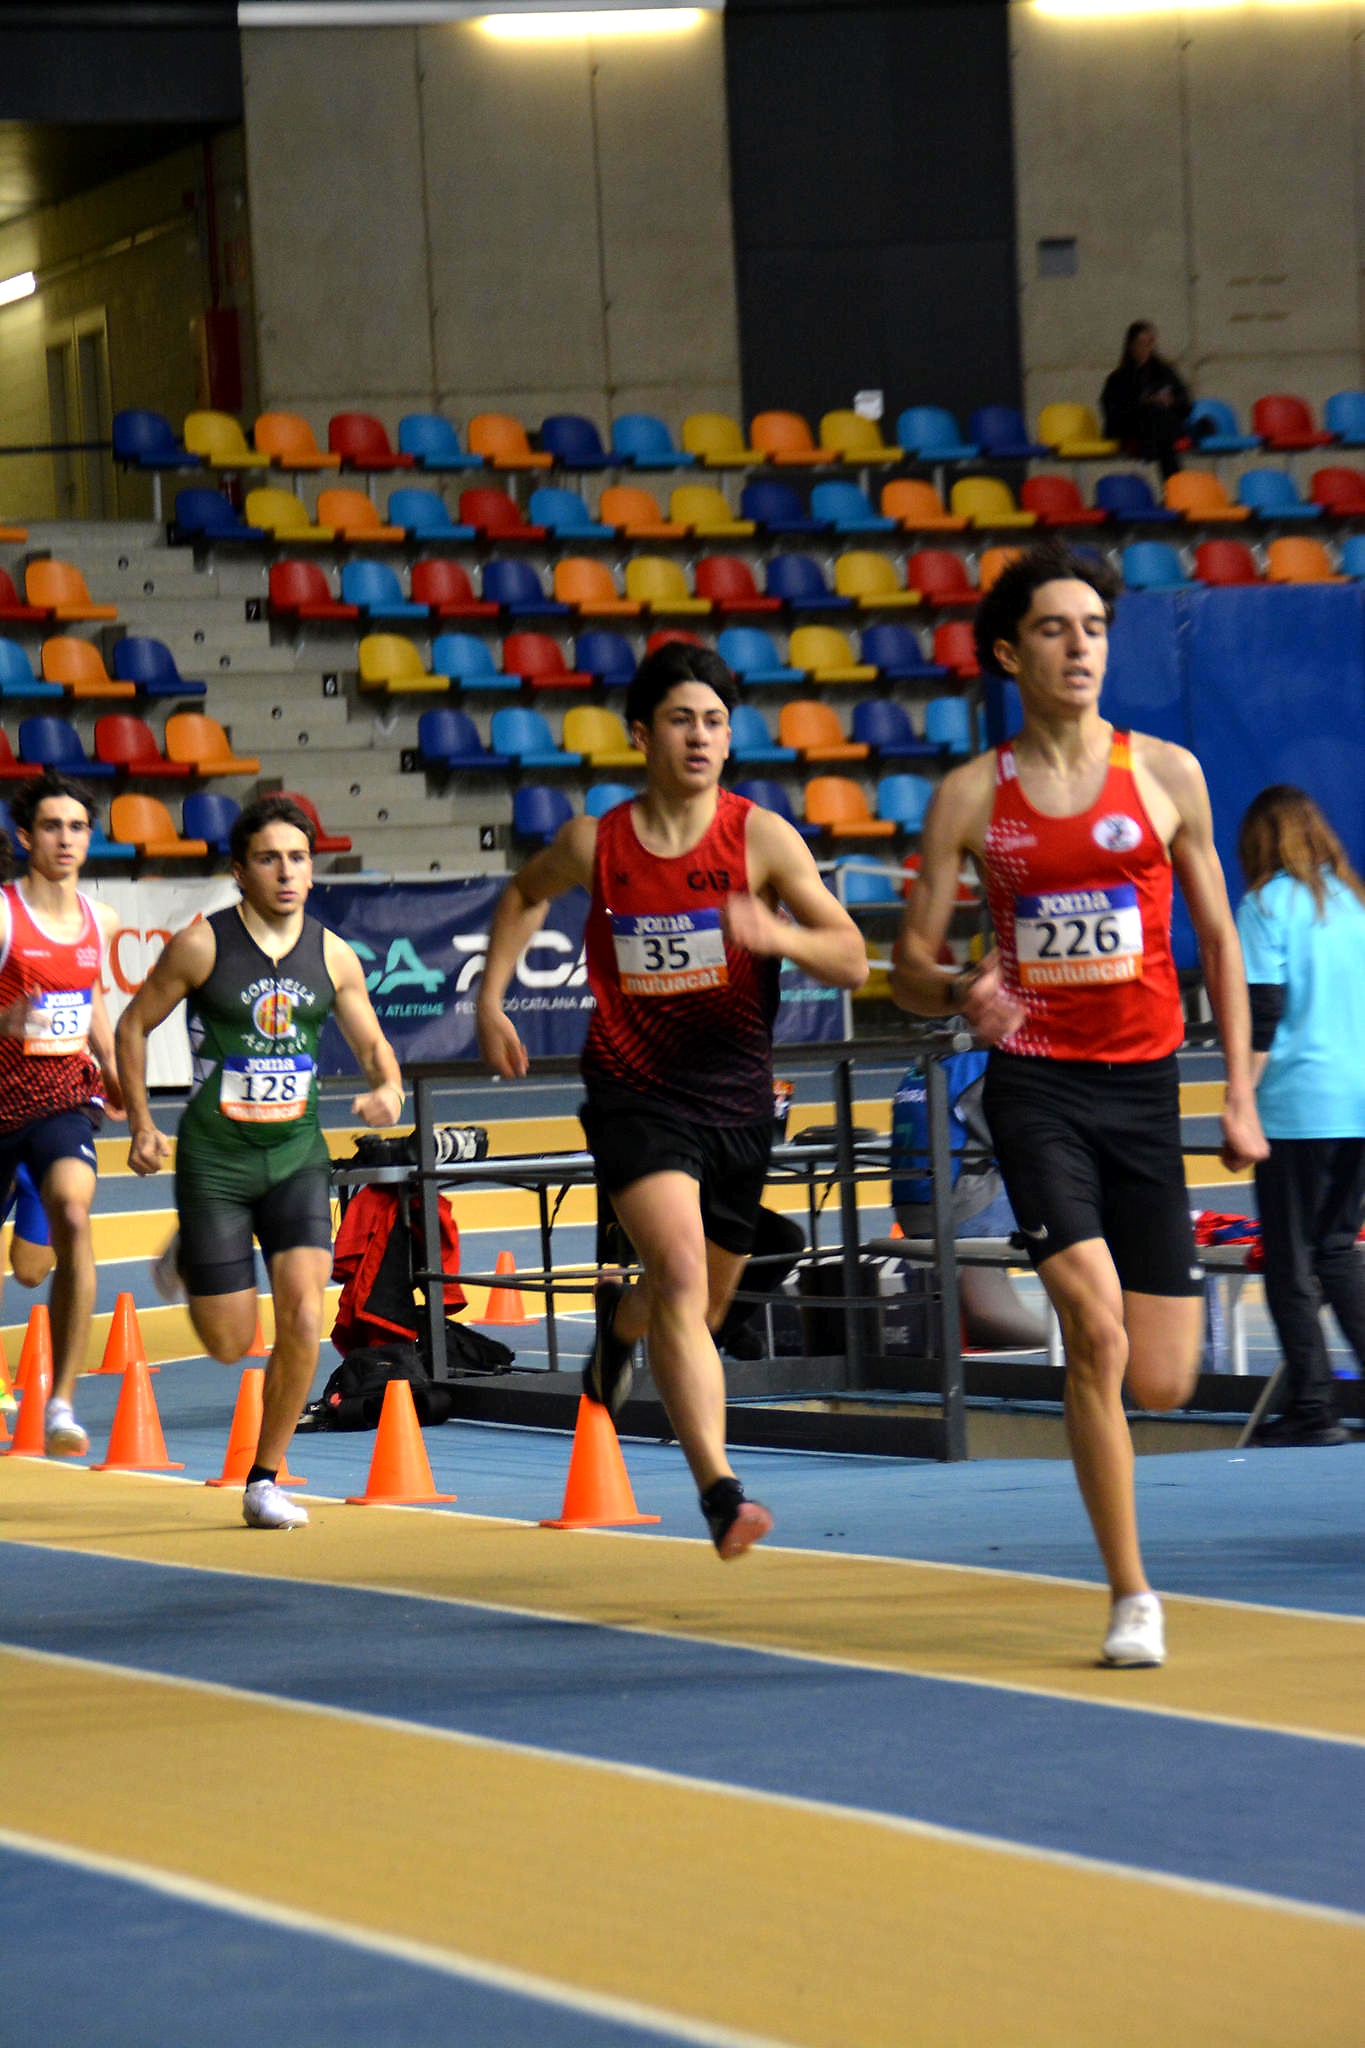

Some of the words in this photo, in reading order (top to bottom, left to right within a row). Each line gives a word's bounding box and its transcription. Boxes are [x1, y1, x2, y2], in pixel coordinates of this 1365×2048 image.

[1035, 917, 1120, 959] 226
[643, 936, 691, 971] 35
[626, 968, 720, 994] mutuacat
[1028, 958, 1136, 985] mutuacat
[385, 1001, 444, 1017] ATLETISME
[521, 996, 578, 1013] CATALANA
[51, 1009, 79, 1036] 63
[240, 1075, 298, 1102] 128
